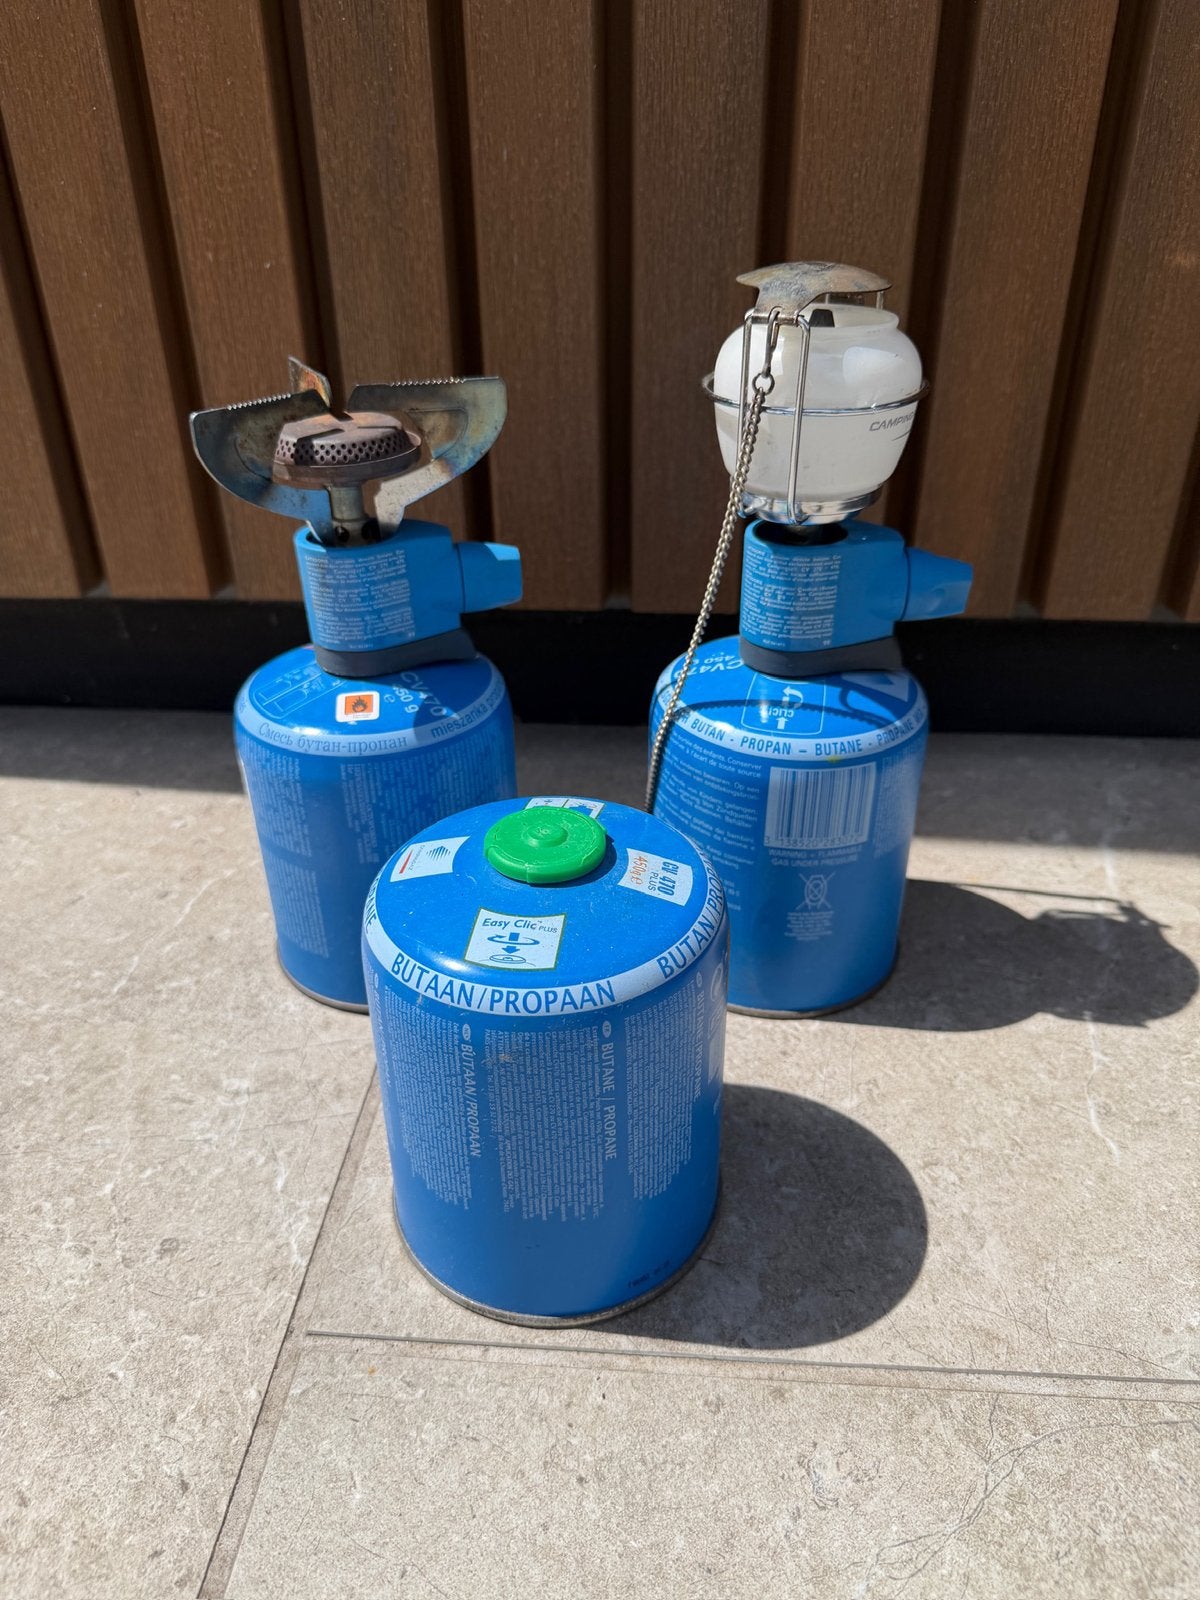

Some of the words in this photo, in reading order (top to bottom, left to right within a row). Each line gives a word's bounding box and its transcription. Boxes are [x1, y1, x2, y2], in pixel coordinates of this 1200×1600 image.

[430, 703, 488, 739] mieszanka
[690, 718, 726, 742] BUTAN
[740, 736, 791, 756] PROPAN
[815, 740, 862, 757] BUTANE
[876, 718, 914, 746] PROPANE
[258, 722, 294, 746] Смесь
[298, 734, 408, 756] бутан-пропан
[648, 872, 659, 892] PLUS
[657, 876, 676, 896] 470
[662, 862, 679, 875] CV
[482, 918, 510, 930] Easy
[391, 952, 616, 1014] BUTAAN/PROPAAN
[602, 1042, 615, 1094] BUTANE
[604, 1105, 616, 1160] PROPANE
